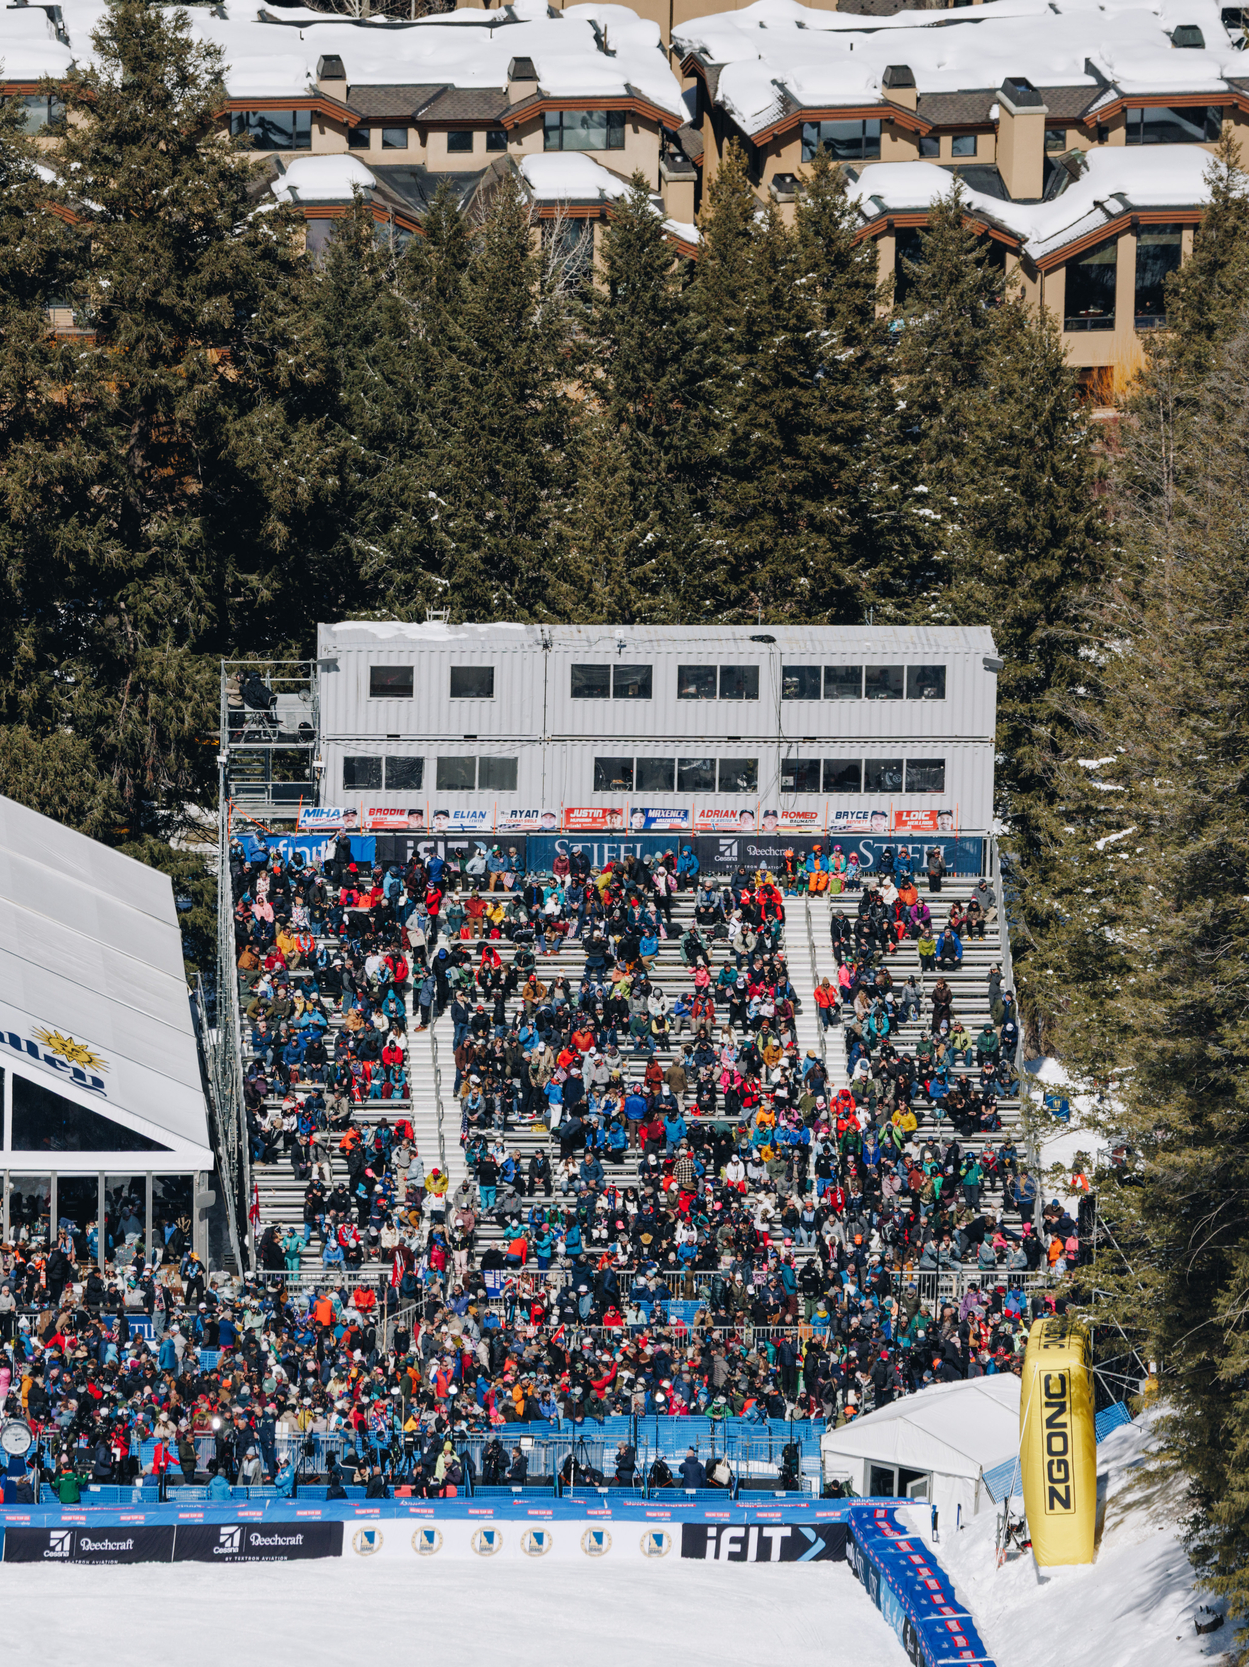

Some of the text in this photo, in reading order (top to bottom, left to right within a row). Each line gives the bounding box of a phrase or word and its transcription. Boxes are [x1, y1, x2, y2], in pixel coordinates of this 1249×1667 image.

[303, 809, 340, 817] MIHA
[368, 808, 406, 816] BRODIE
[453, 811, 487, 819] ELIAN
[510, 810, 539, 818] RYAN
[570, 809, 603, 817] JUSTIN
[648, 809, 685, 817] MAXENCE
[699, 810, 737, 818] ADRIAN
[781, 811, 818, 819] ROMED
[835, 811, 869, 819] BRYCE
[859, 839, 953, 868] STFEL
[1044, 1373, 1072, 1511] ZGONC
[250, 1532, 304, 1545] Beechcraft
[80, 1538, 134, 1550] Beechcraft
[705, 1527, 792, 1562] iFIT
[213, 1546, 239, 1554] Cessna
